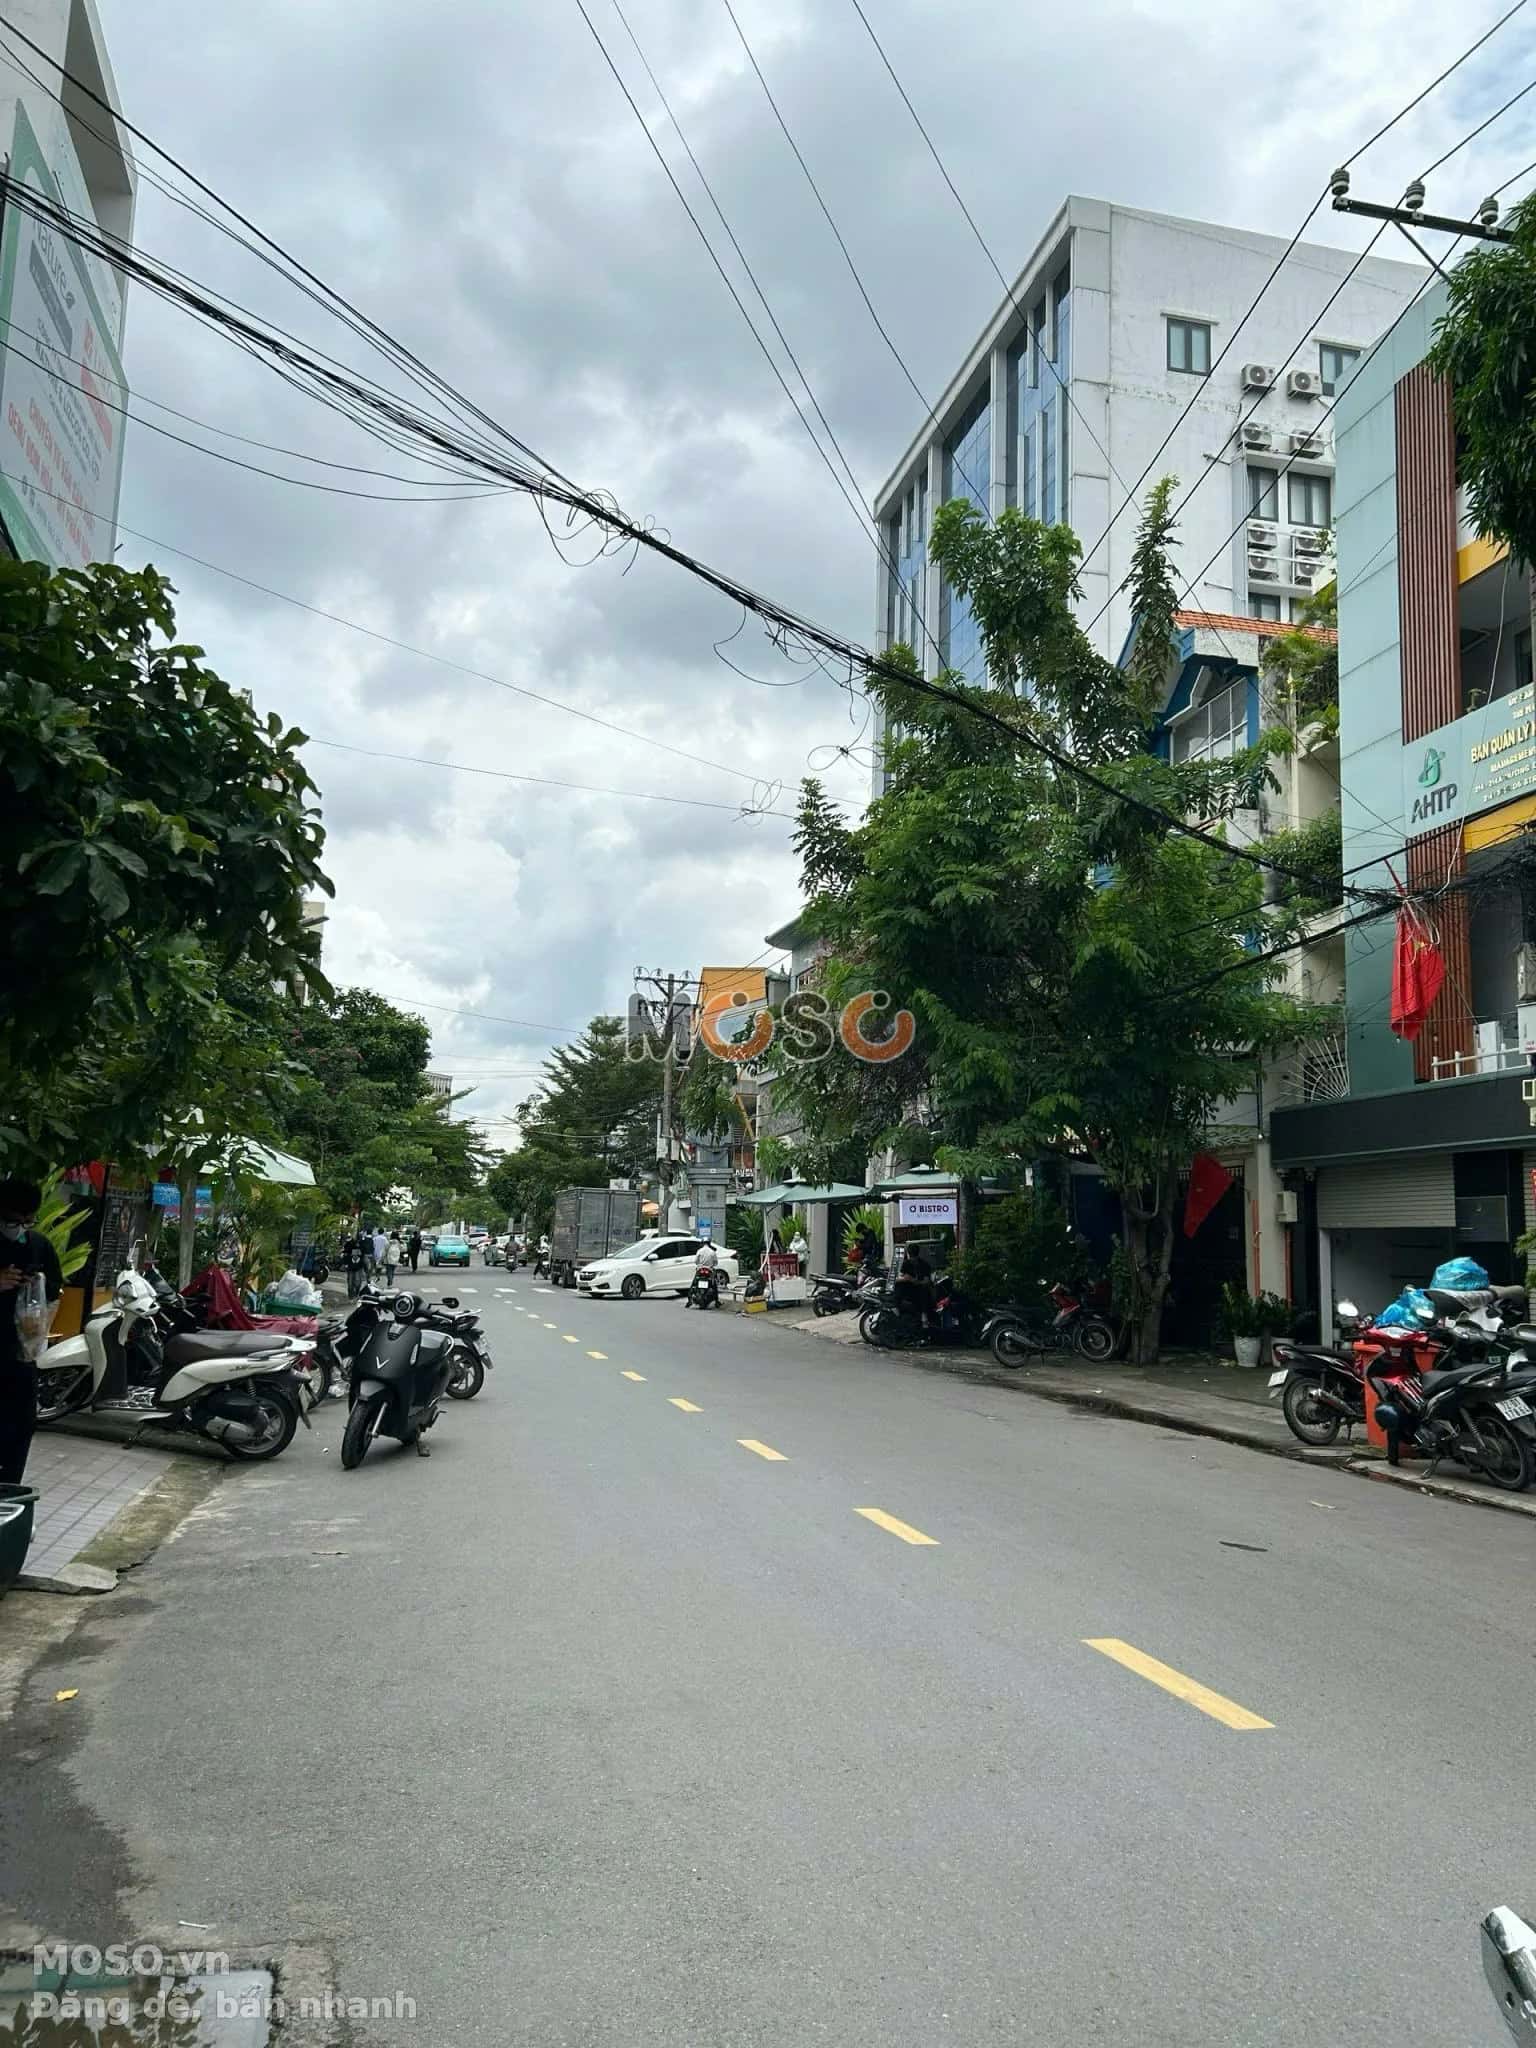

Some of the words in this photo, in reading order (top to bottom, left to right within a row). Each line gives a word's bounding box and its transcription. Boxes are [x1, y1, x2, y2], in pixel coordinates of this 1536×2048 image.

[1471, 741, 1490, 763] BAN
[1411, 783, 1458, 824] AHTP
[919, 1204, 950, 1213] BISTRO
